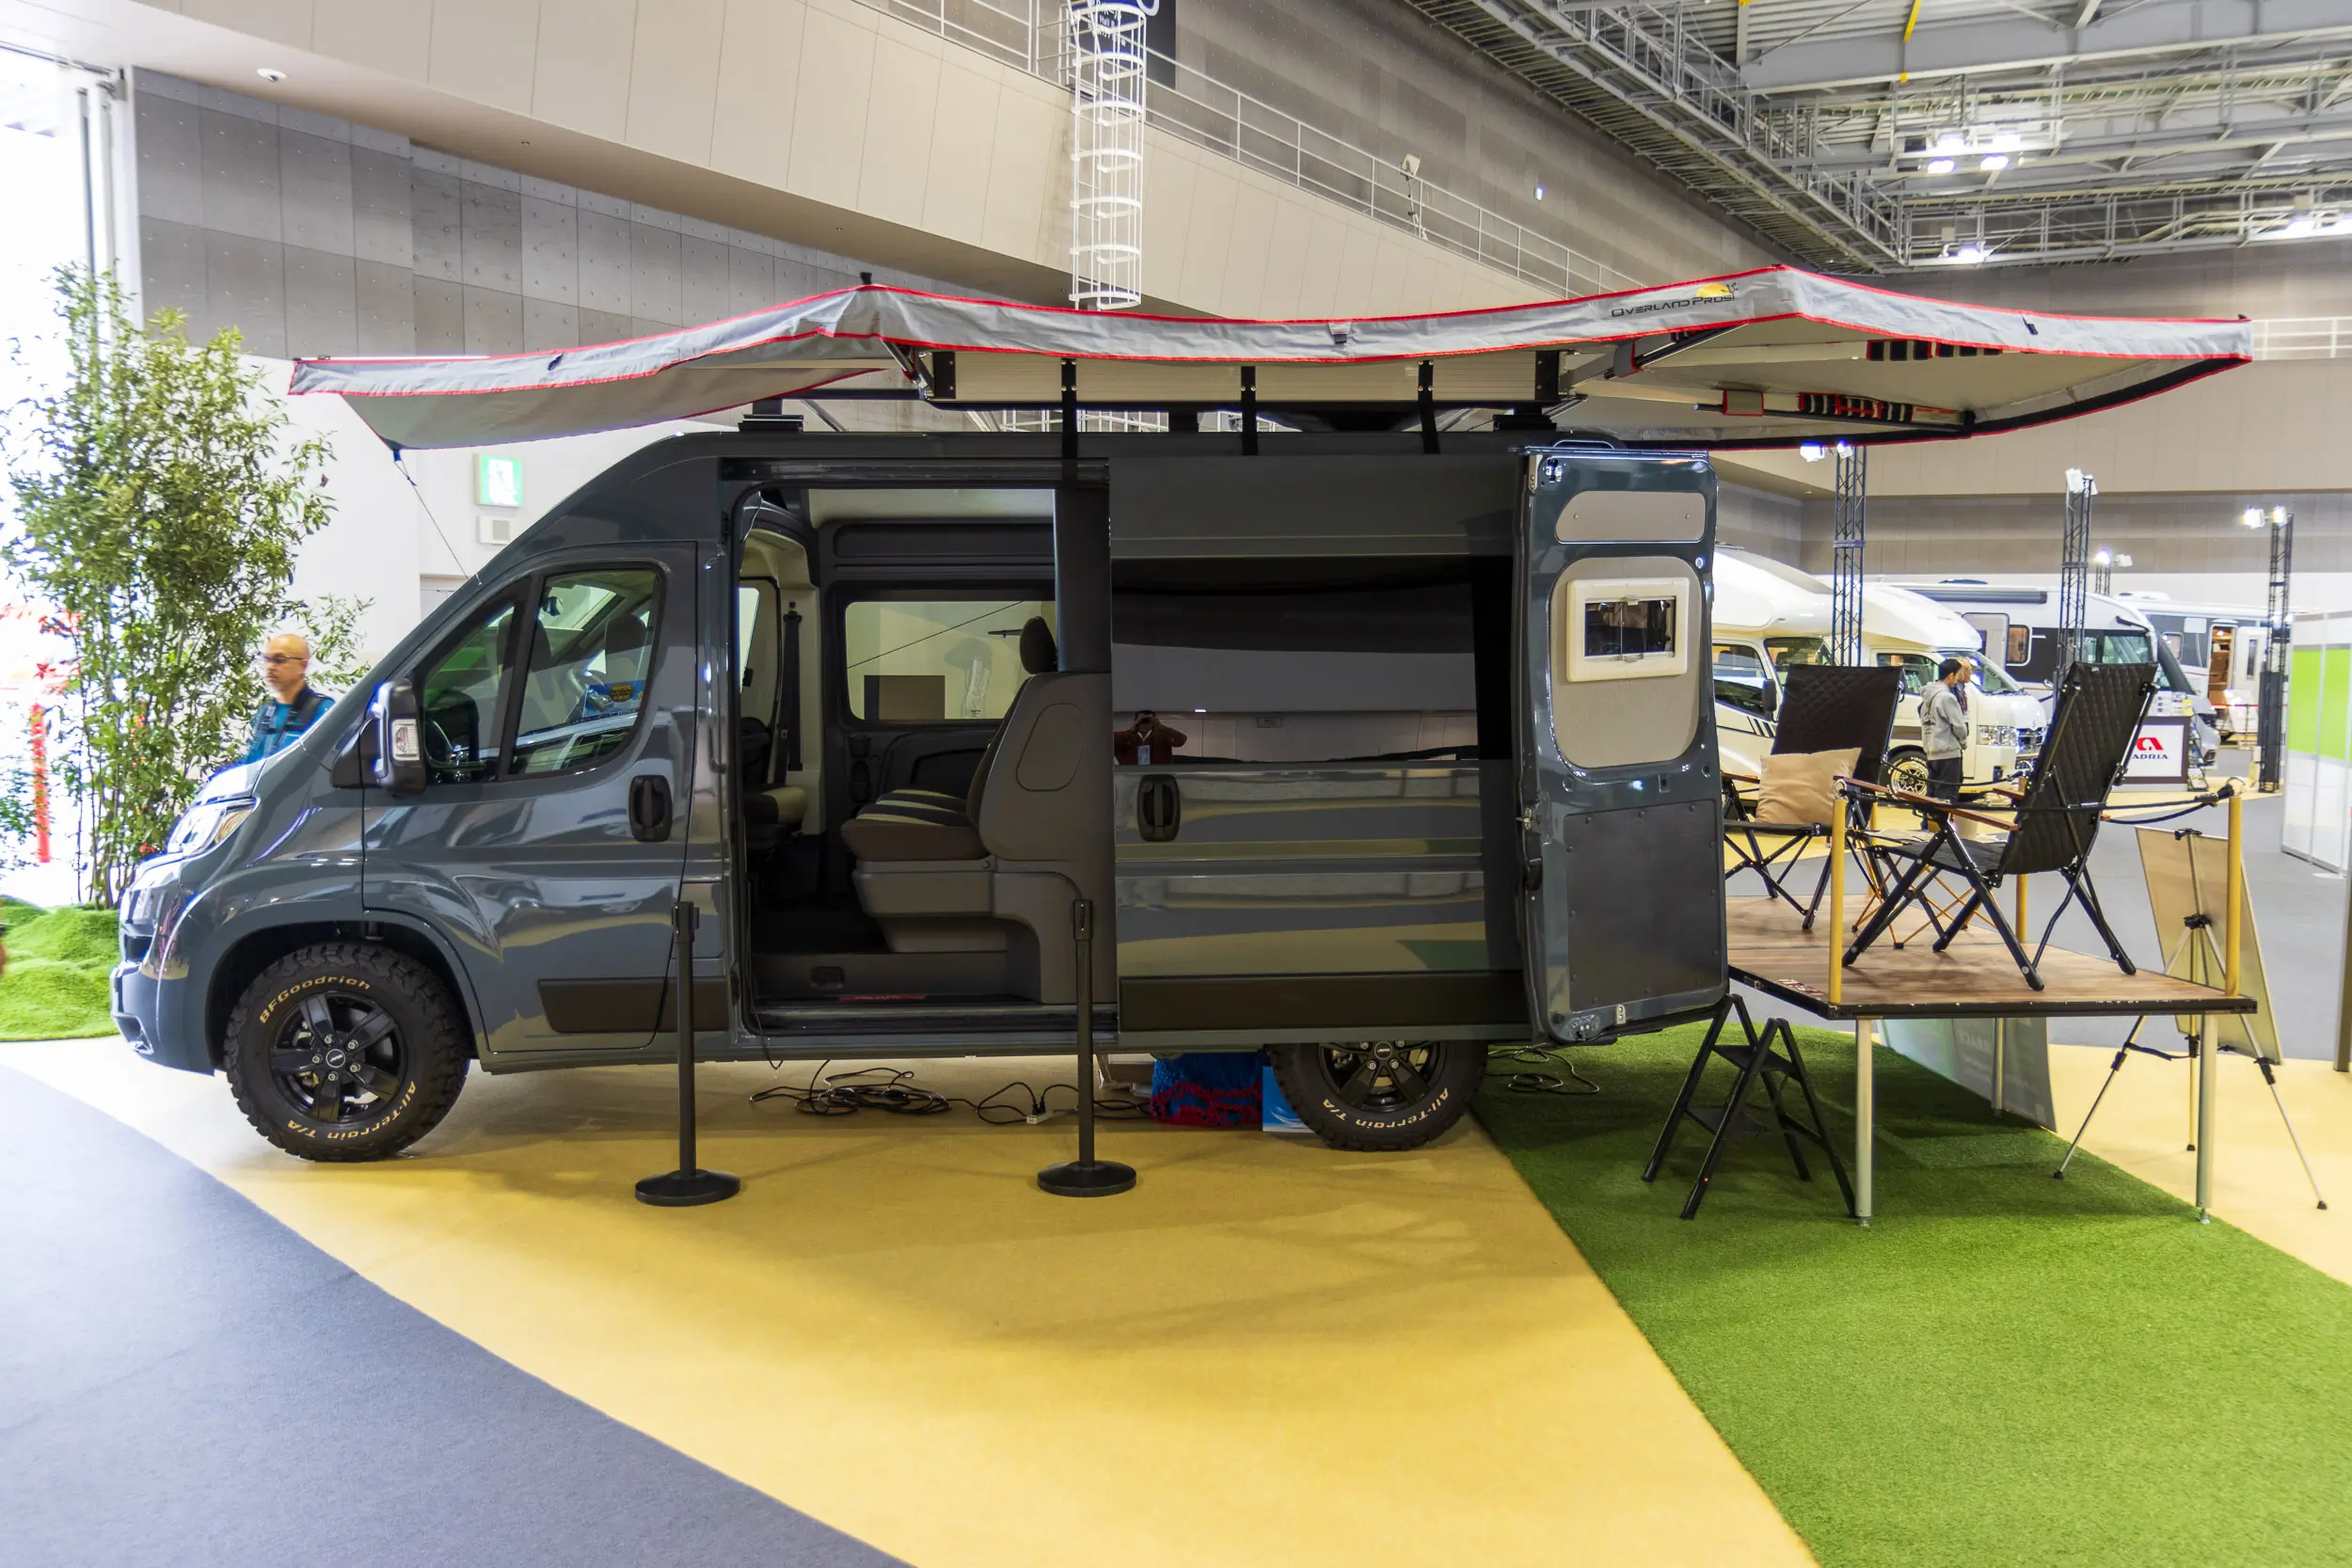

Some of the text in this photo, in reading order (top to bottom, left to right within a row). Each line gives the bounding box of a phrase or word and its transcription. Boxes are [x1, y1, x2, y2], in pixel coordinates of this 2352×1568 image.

[259, 974, 372, 1025] BFGoodrich
[286, 1080, 418, 1141] All-Terrain T/A
[1322, 1086, 1451, 1130] All-Terrain T/A
